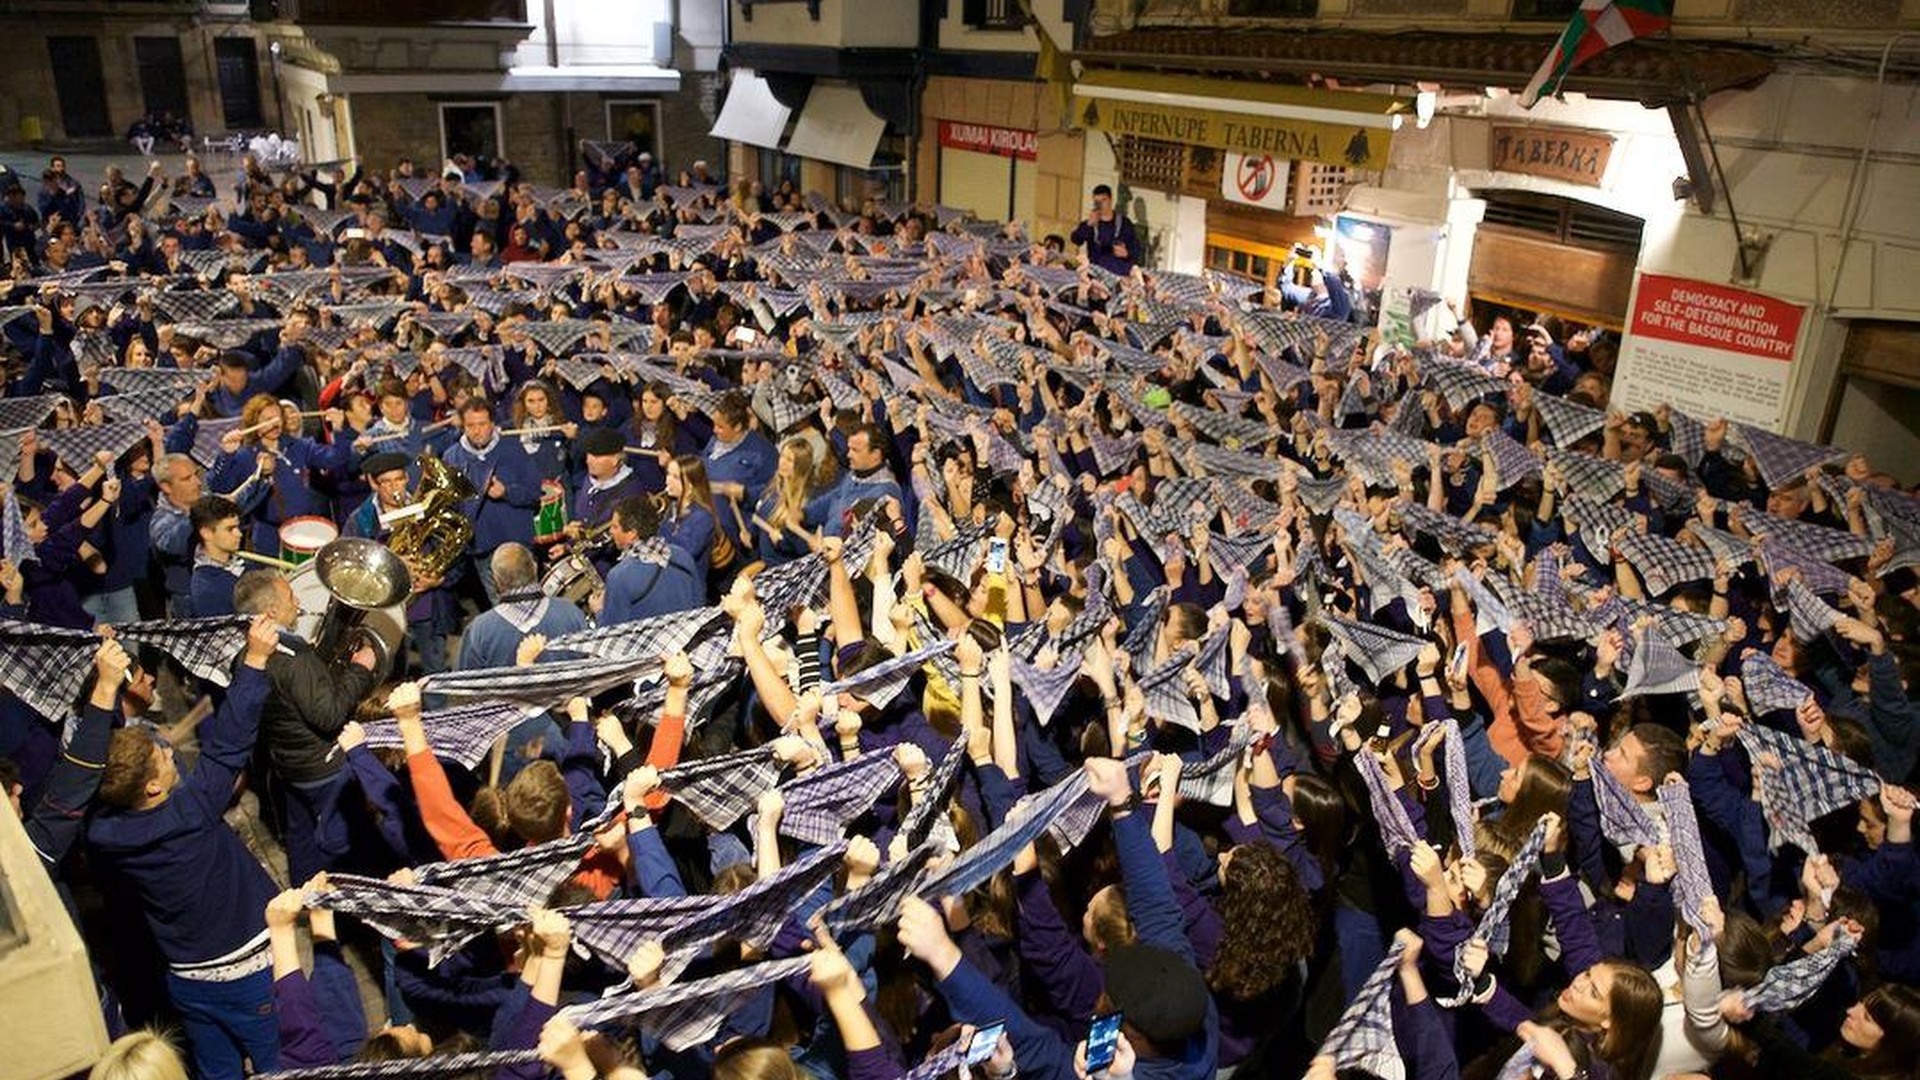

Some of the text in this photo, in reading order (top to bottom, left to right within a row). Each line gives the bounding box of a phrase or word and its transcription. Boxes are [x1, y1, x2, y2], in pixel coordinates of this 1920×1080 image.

[1113, 109, 1321, 157] INPERNUPE TABERNA
[1654, 299, 1779, 336] SELF-DETERMINATION
[1671, 289, 1766, 318] DEMOCRACY AND
[1641, 312, 1794, 355] FOR THE BASQUE COUNTRY
